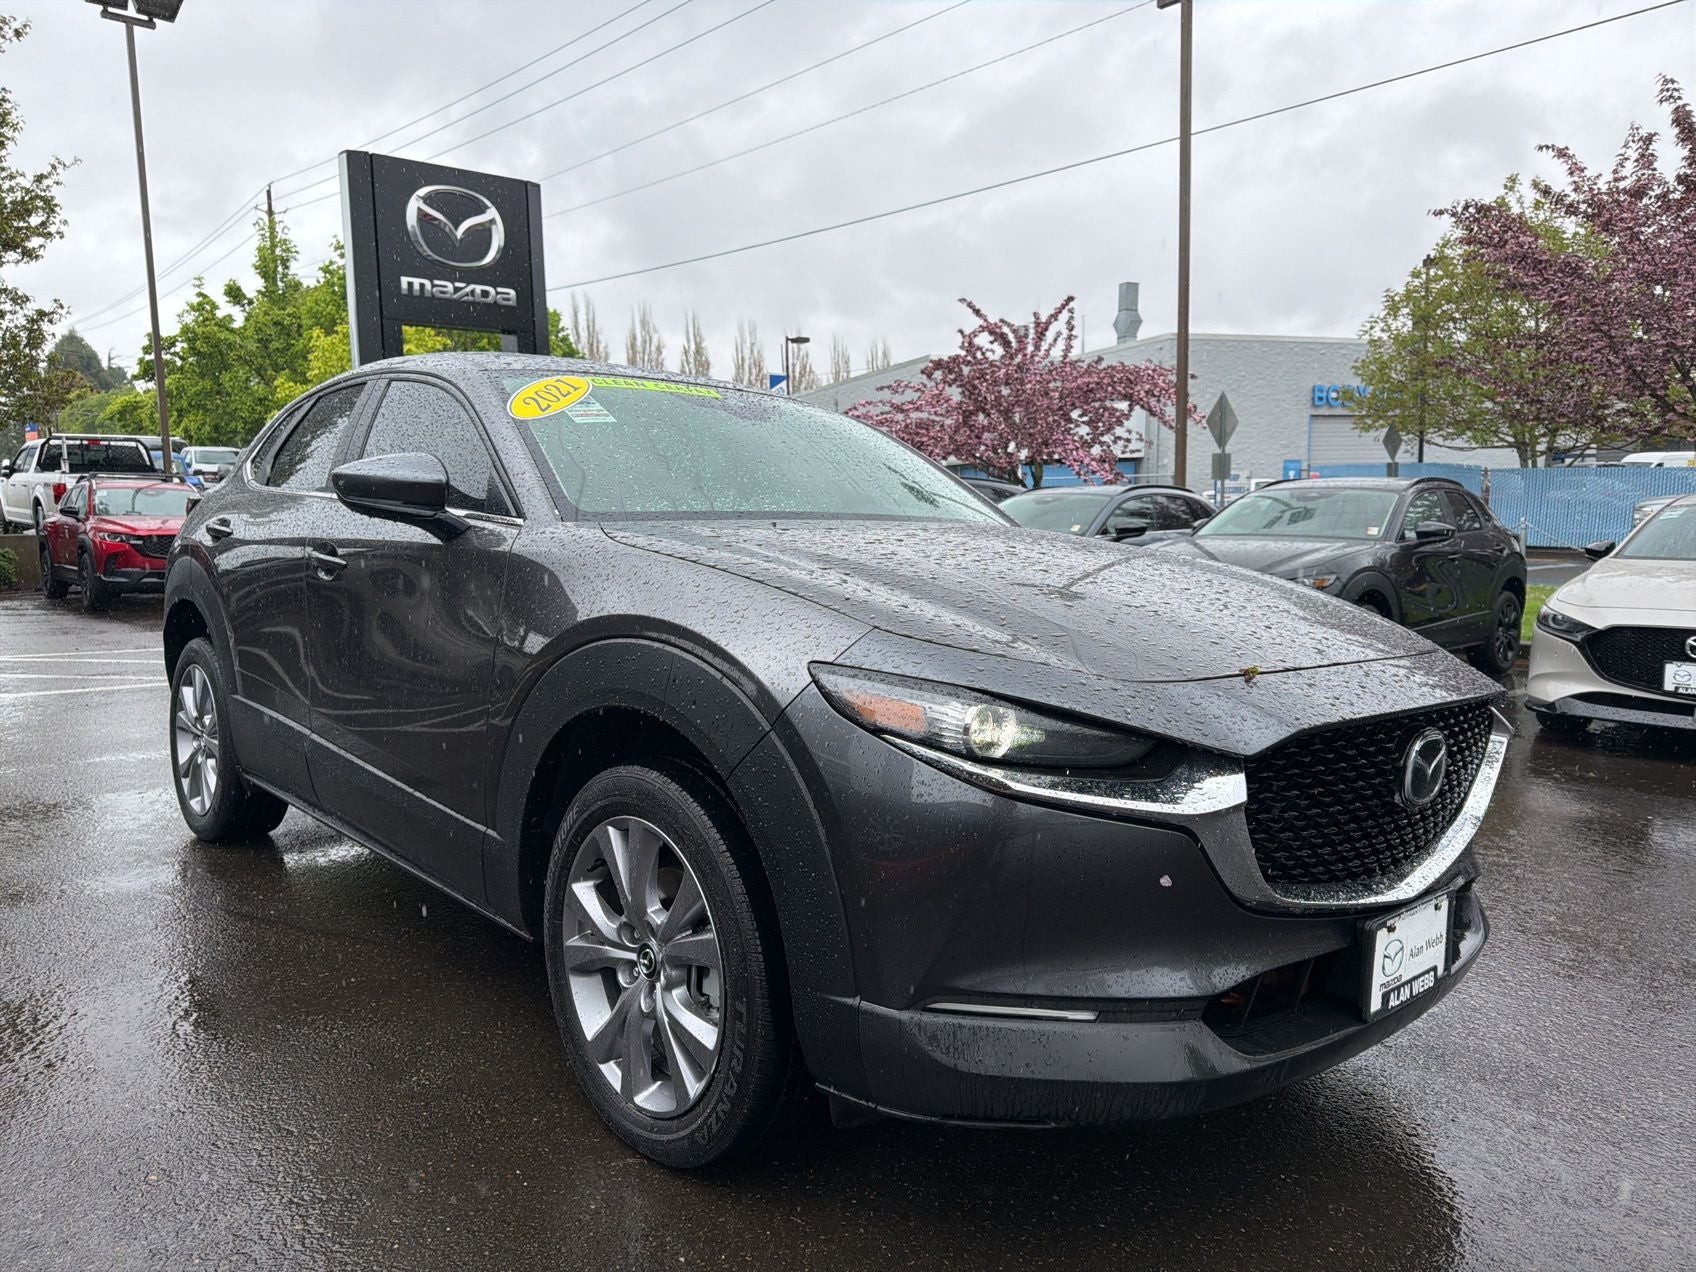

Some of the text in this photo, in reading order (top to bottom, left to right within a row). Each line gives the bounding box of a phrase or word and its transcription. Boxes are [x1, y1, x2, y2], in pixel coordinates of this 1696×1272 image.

[522, 378, 582, 413] 2021
[591, 378, 648, 388] CLEAN
[1408, 931, 1444, 961] Alan Webb
[1388, 971, 1435, 1010] ALAN WEBB
